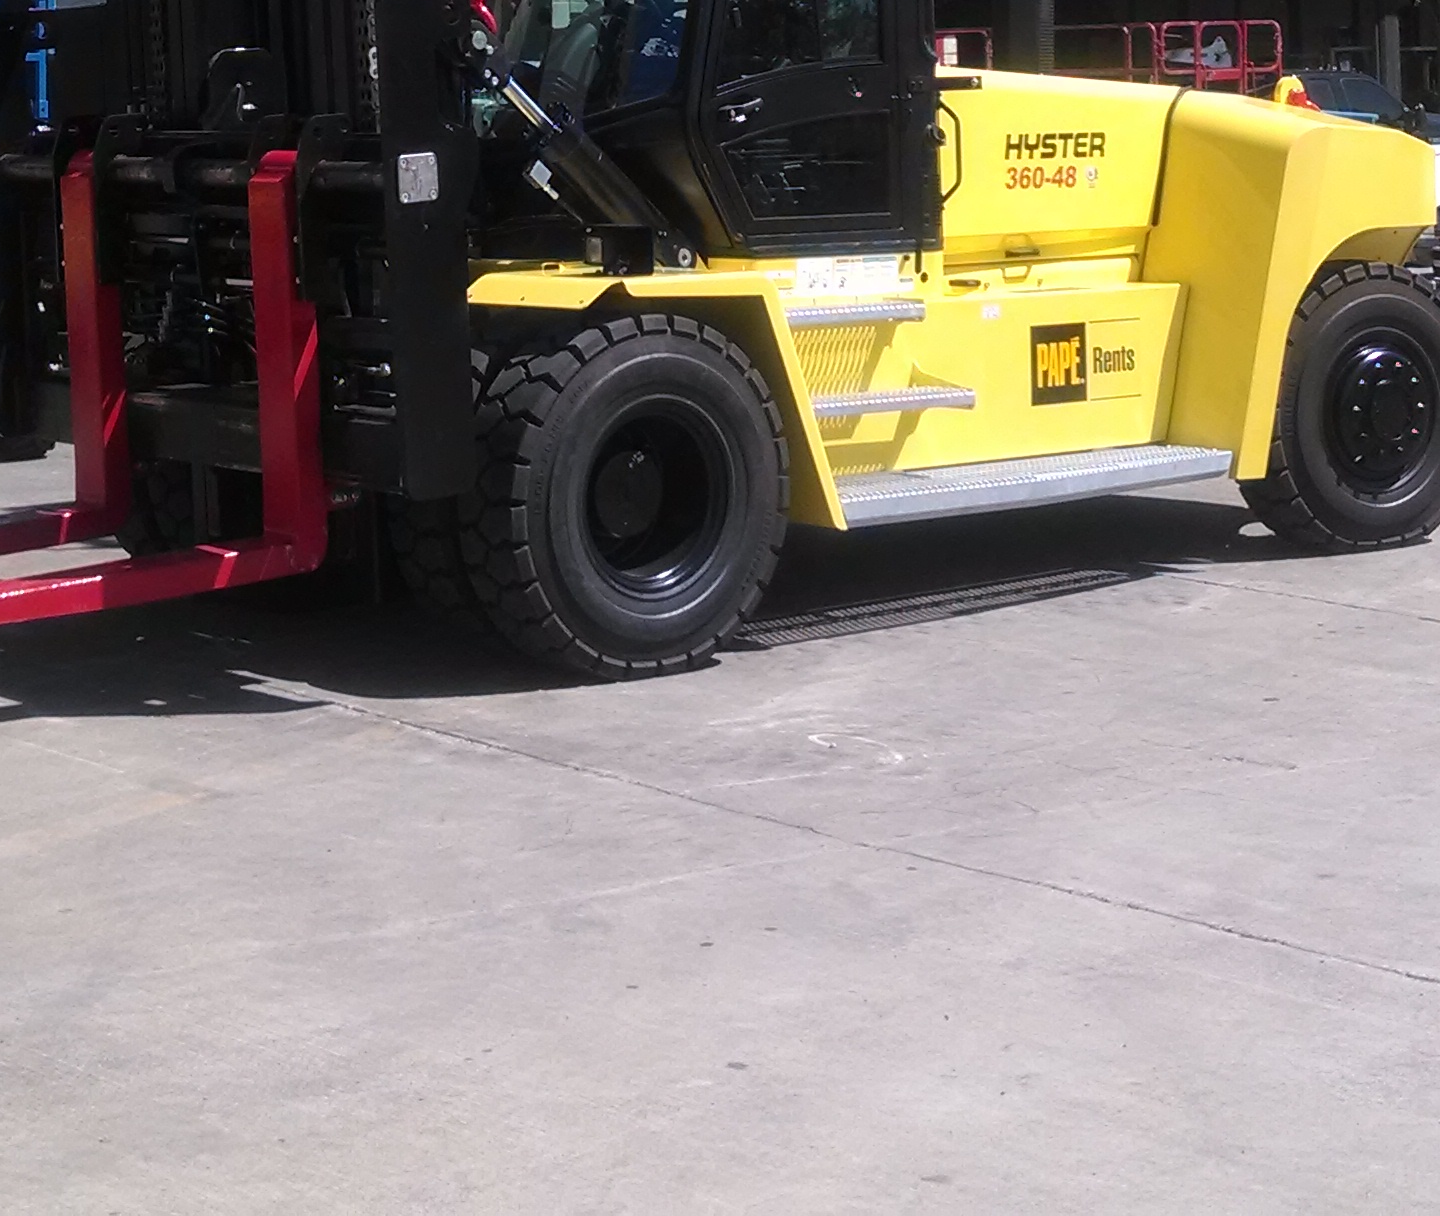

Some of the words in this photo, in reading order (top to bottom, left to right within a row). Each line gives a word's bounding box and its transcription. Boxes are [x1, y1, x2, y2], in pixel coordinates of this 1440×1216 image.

[1005, 132, 1106, 160] HYSTER
[1005, 165, 1077, 190] 360-48
[1093, 346, 1135, 374] Rents
